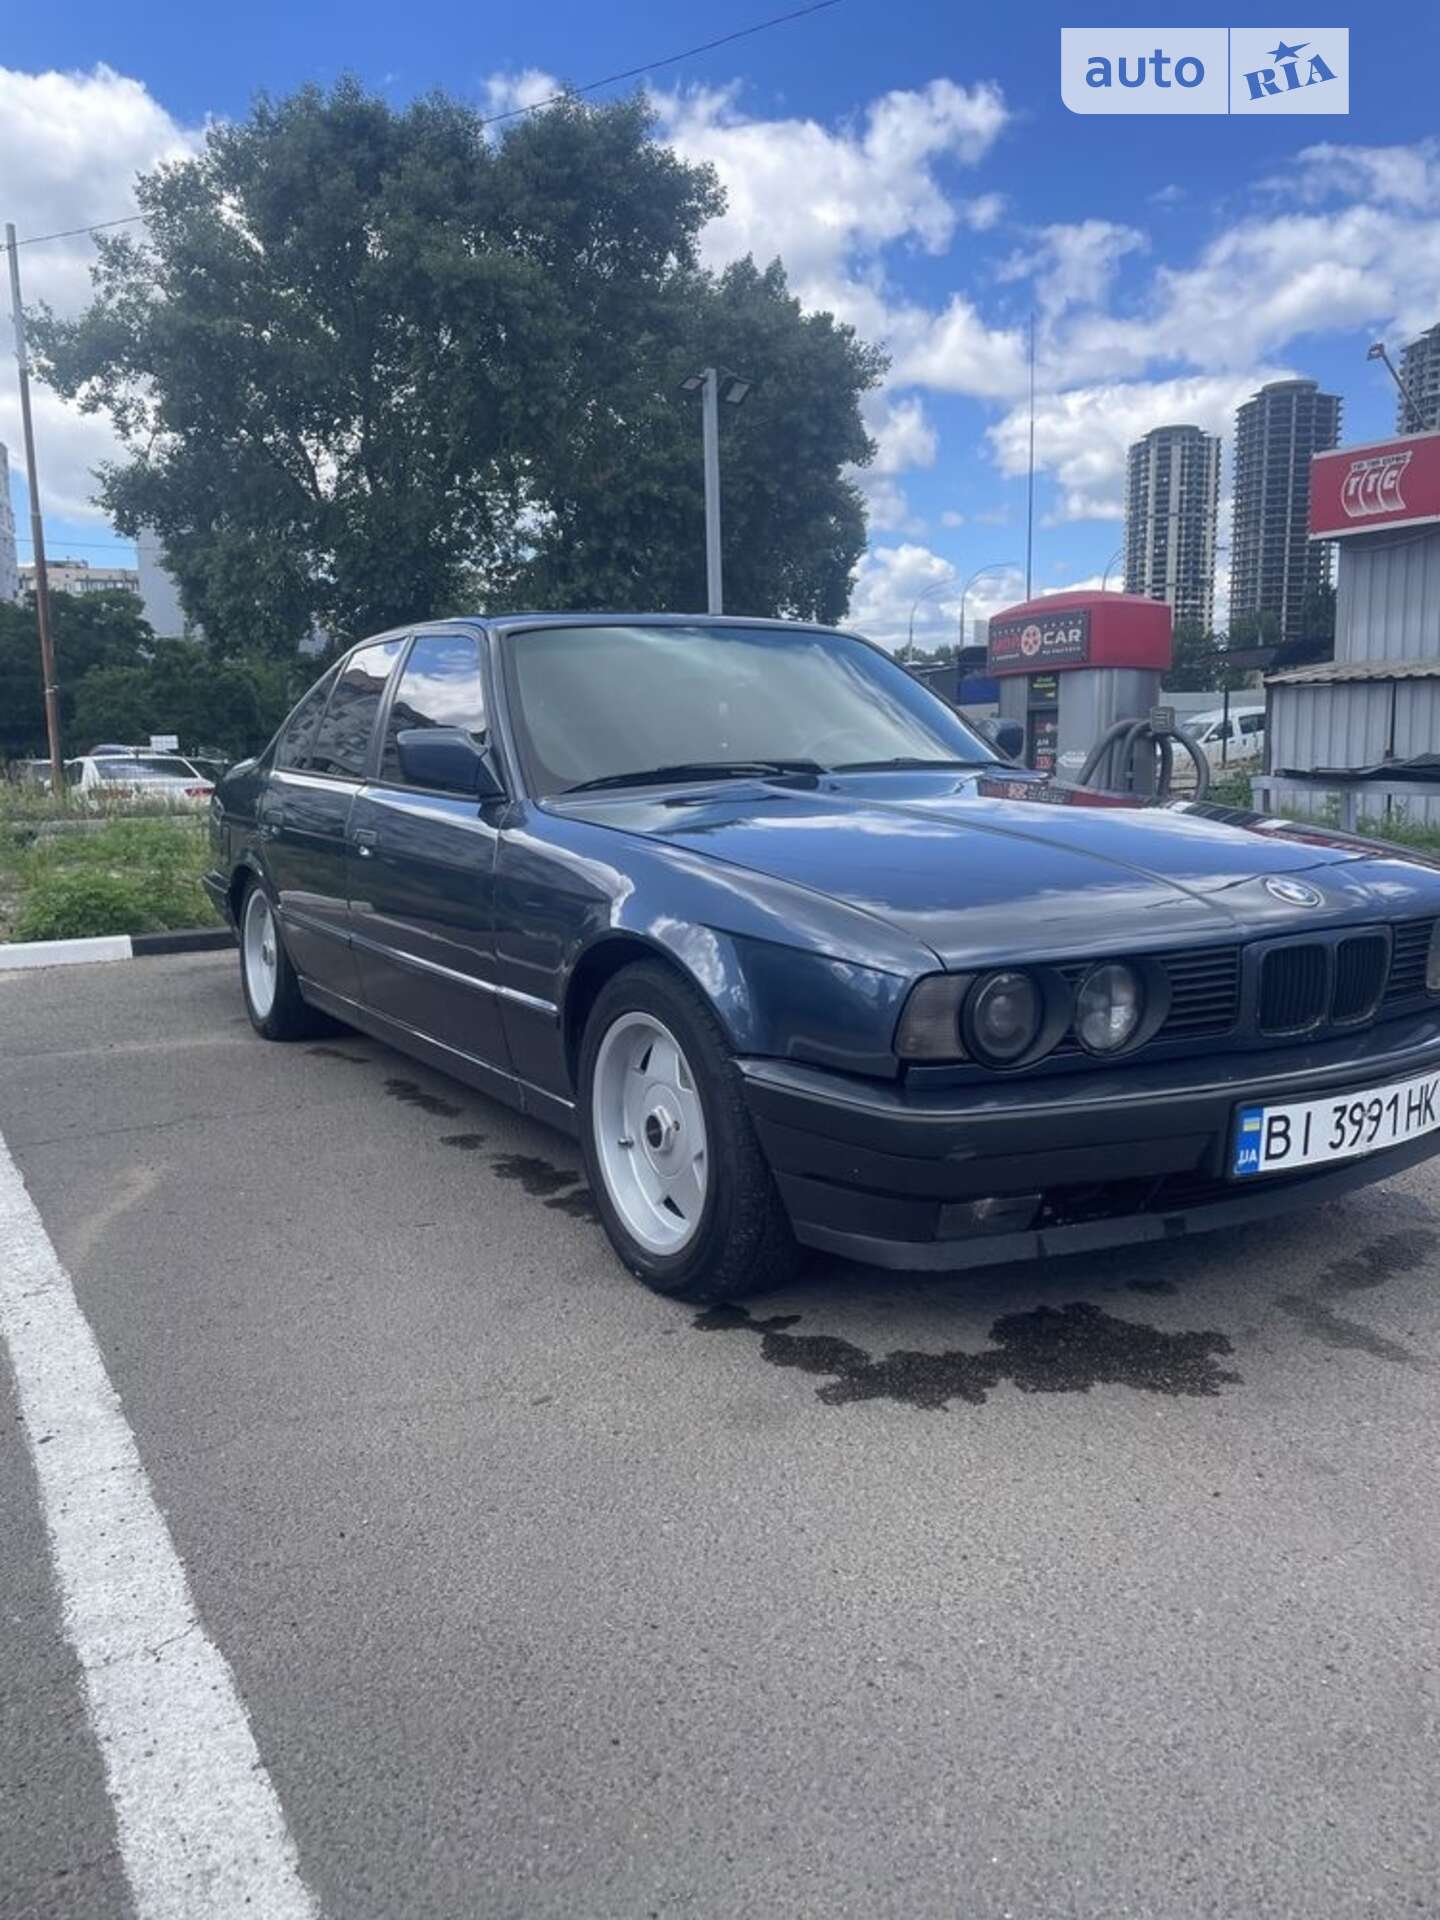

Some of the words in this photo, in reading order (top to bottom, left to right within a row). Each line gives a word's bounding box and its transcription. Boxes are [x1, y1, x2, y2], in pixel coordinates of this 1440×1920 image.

[1043, 628, 1082, 646] CAR
[1264, 1111, 1311, 1160] BI
[1328, 1092, 1400, 1150] 3991
[1405, 1079, 1439, 1132] HK
[1238, 1148, 1257, 1164] UA
